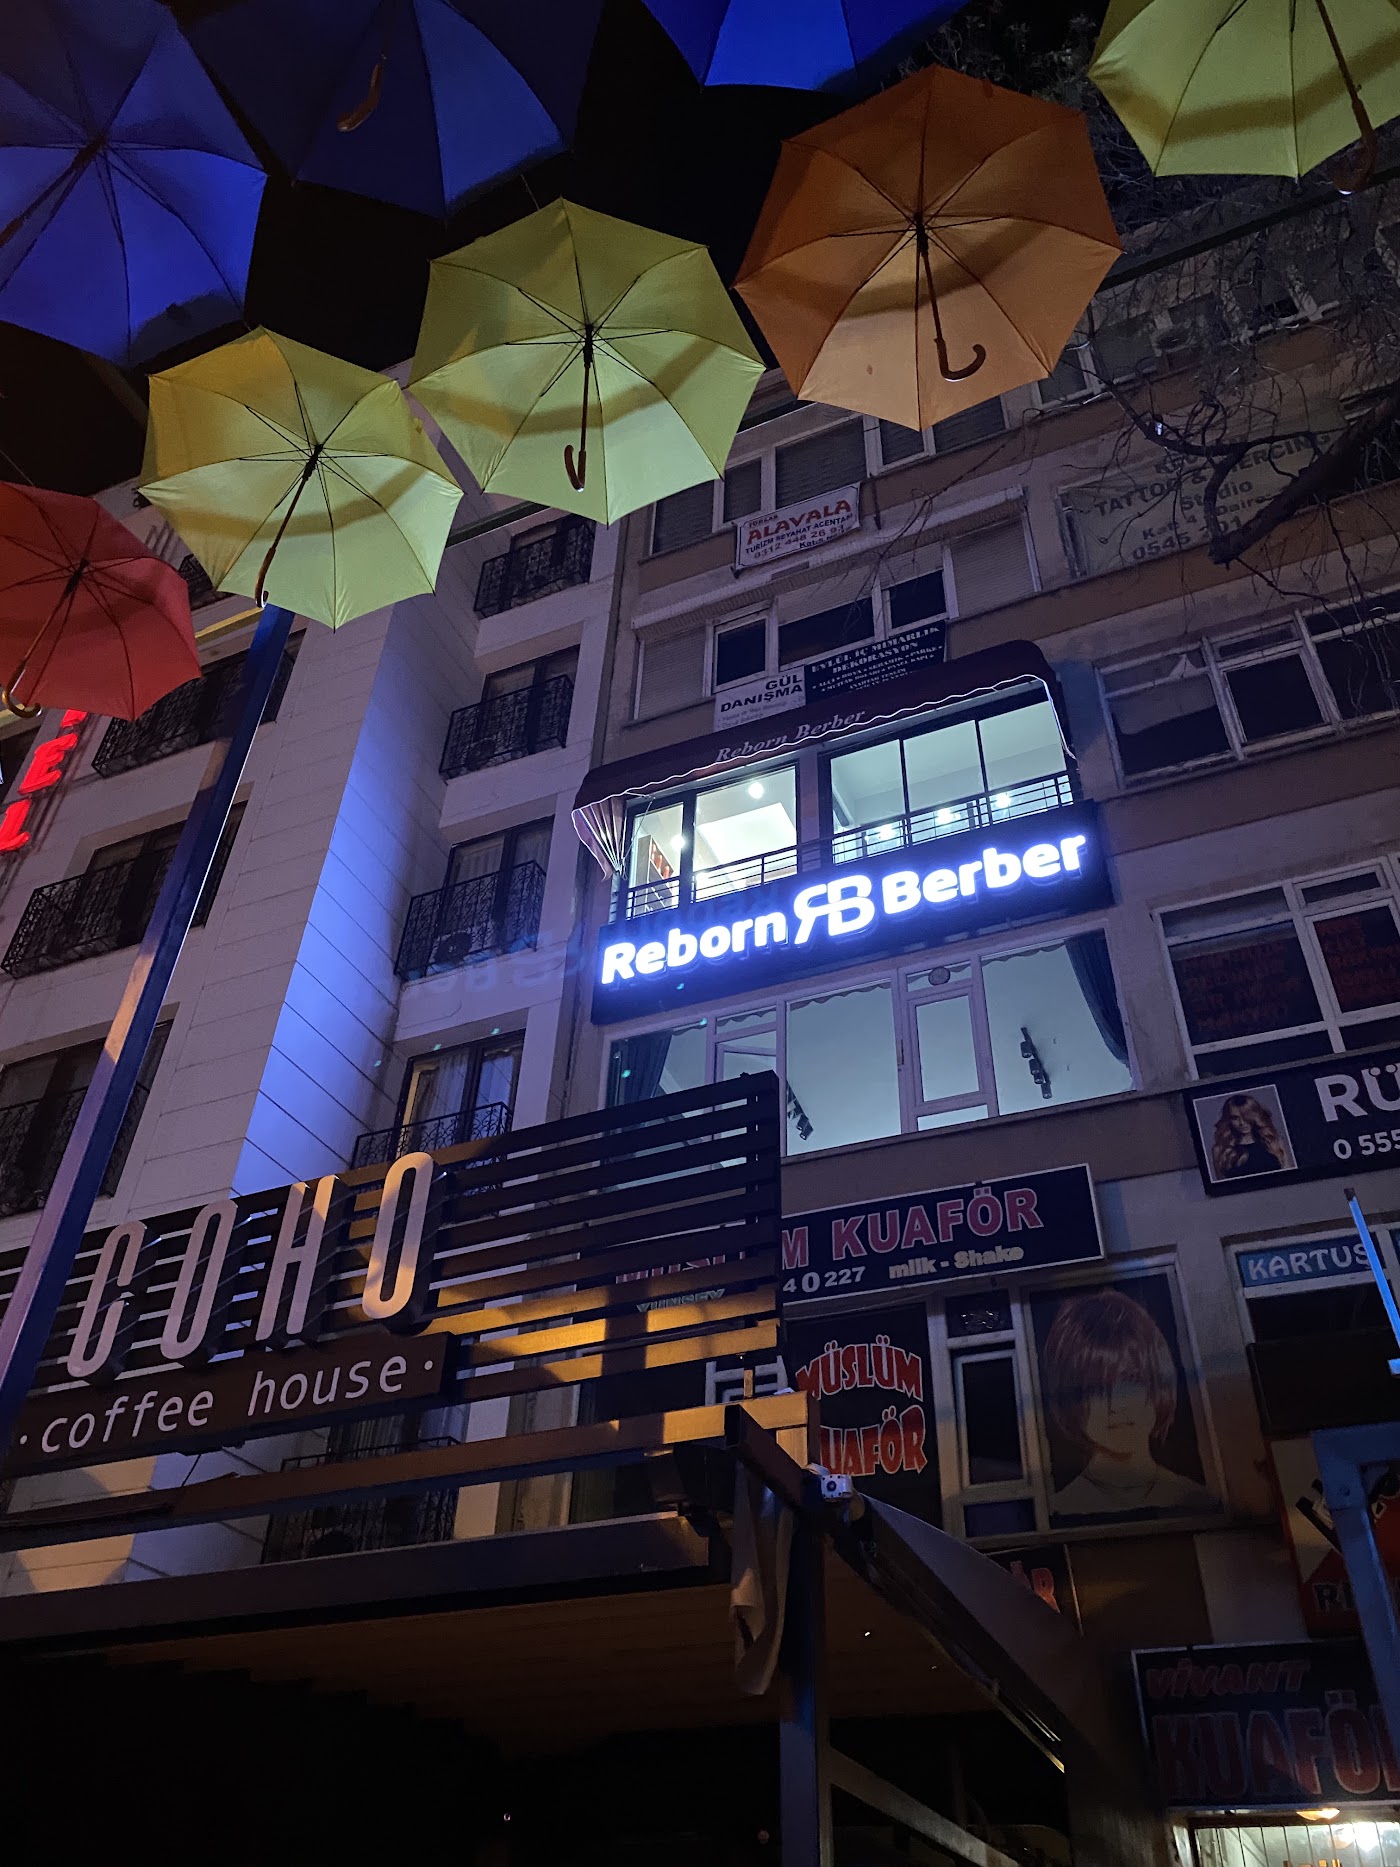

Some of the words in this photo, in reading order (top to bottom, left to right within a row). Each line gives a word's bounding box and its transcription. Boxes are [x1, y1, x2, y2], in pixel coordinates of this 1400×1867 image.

[1181, 481, 1253, 510] Stdio
[747, 500, 851, 545] ALAVALA
[765, 674, 803, 690] GÜL
[832, 641, 918, 674] DEKORASYON
[720, 684, 803, 712] DANIŞMA
[715, 735, 788, 763] Reborn
[795, 711, 866, 740] Berber
[600, 911, 788, 985] Reborn
[882, 834, 1087, 914] Berber
[831, 1186, 1044, 1261] KUAFÖR
[67, 1151, 434, 1378] COHO
[953, 1244, 1025, 1269] Shake
[795, 1334, 924, 1402] MÜSLÜM
[41, 1391, 215, 1453] coffee
[247, 1355, 408, 1417] house
[820, 1404, 928, 1477] UAFÖR
